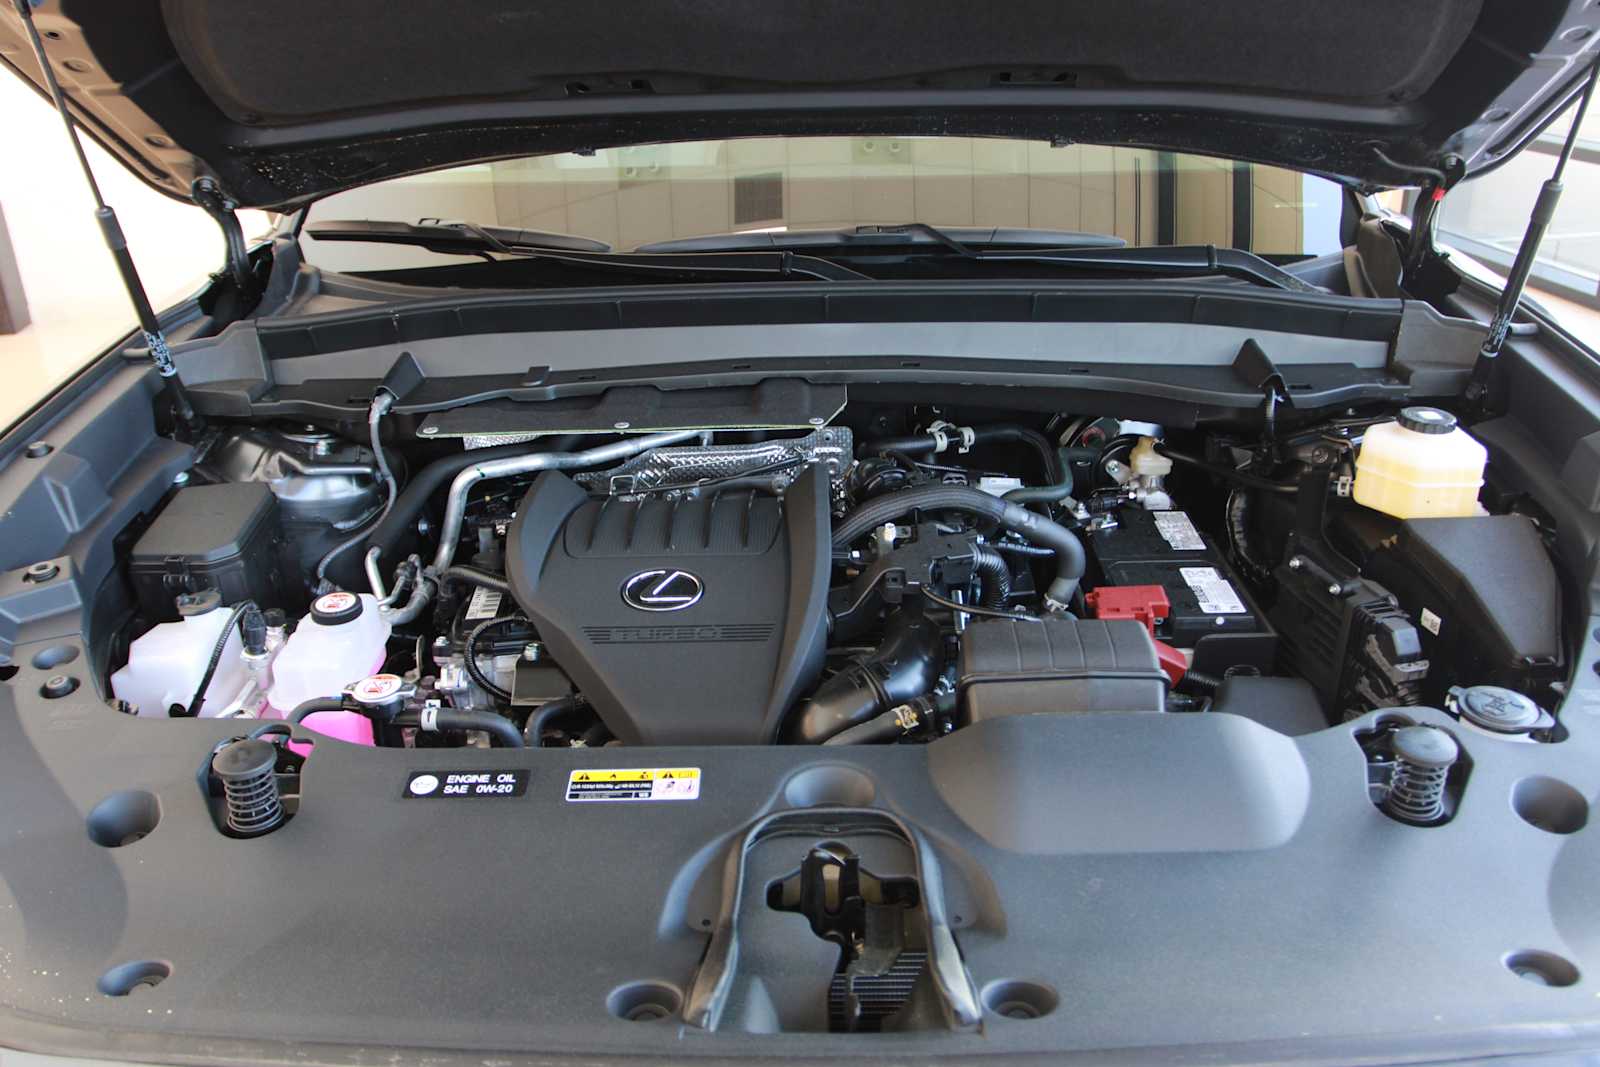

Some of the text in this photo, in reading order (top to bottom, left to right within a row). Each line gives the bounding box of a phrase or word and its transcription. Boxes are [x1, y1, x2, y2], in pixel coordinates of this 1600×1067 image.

[614, 628, 716, 641] TURBO
[446, 774, 516, 784] ENGINE OIL
[443, 784, 513, 794] SAE 0W-20
